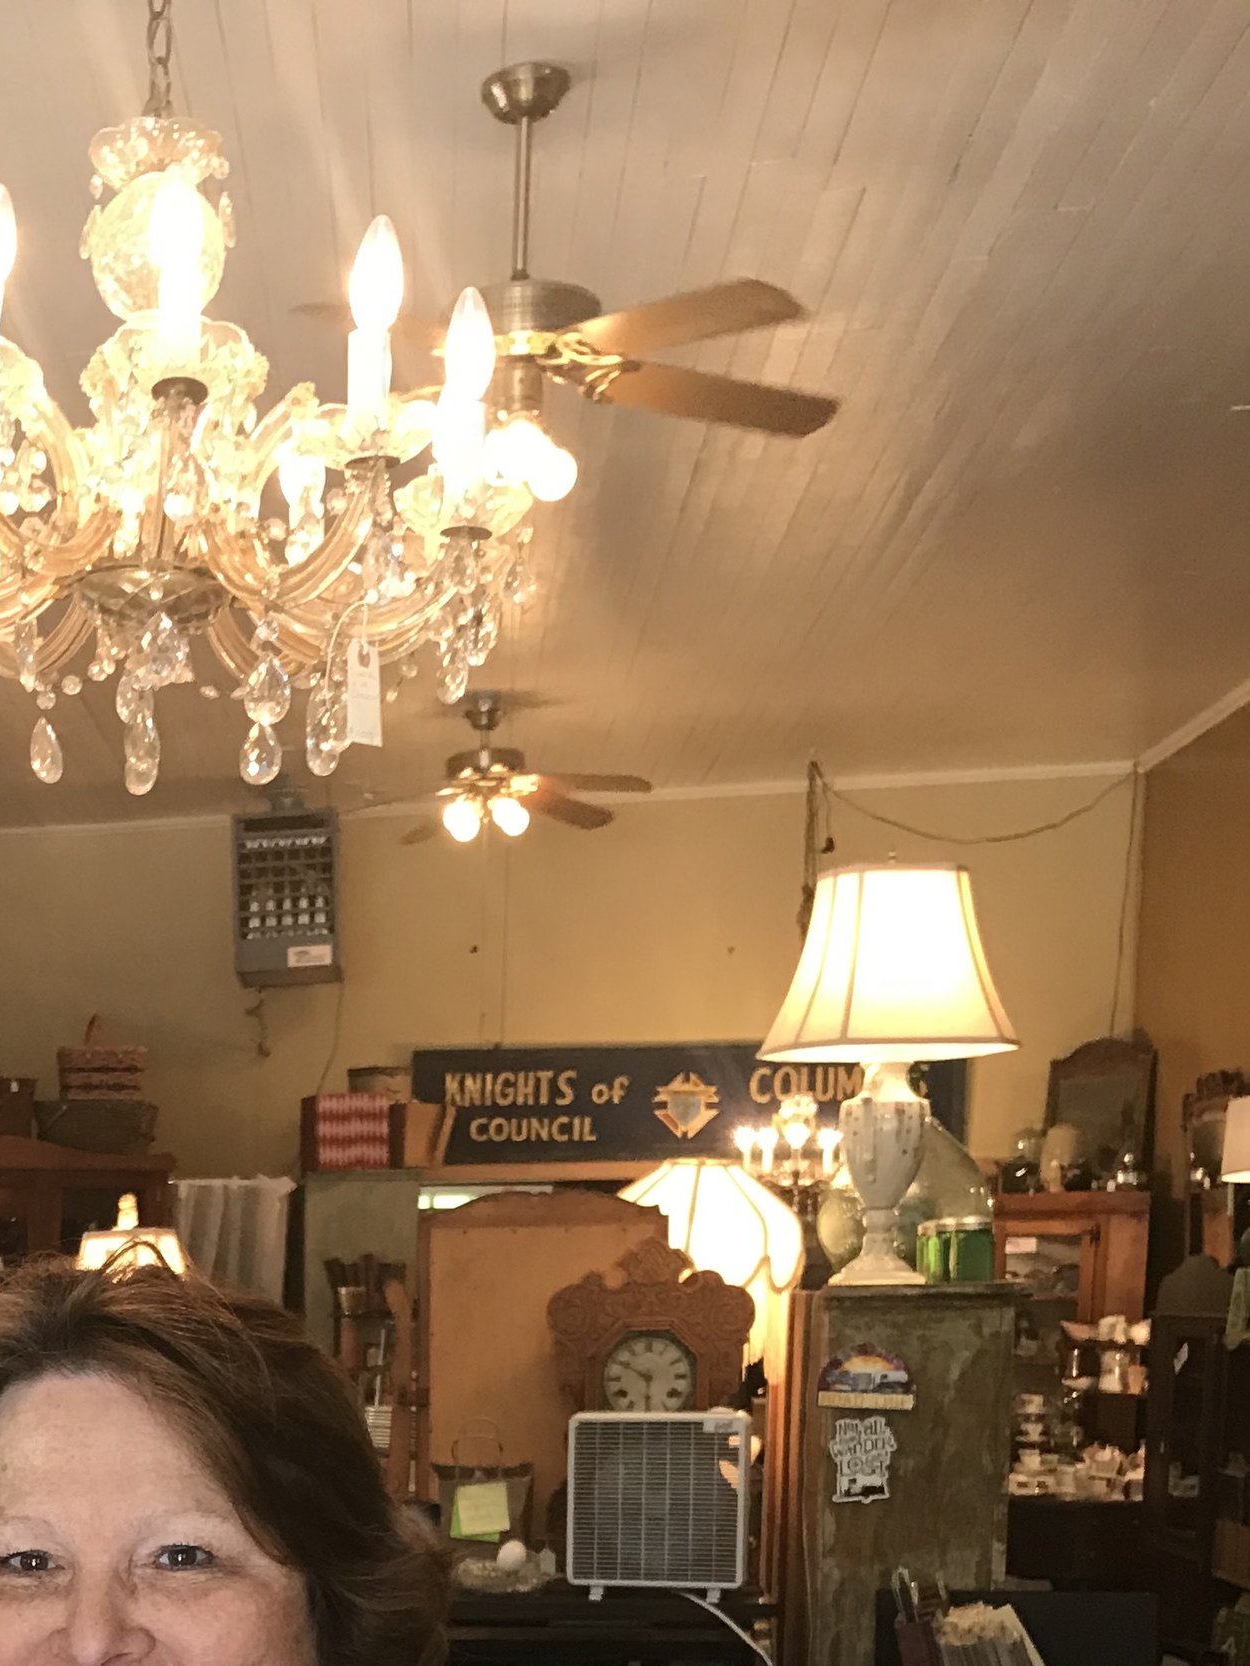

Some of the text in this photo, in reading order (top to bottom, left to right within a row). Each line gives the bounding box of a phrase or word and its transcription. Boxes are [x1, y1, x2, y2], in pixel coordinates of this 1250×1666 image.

[445, 1065, 929, 1107] KNIGHTS of COLUM
[469, 1115, 598, 1142] COUNCIL
